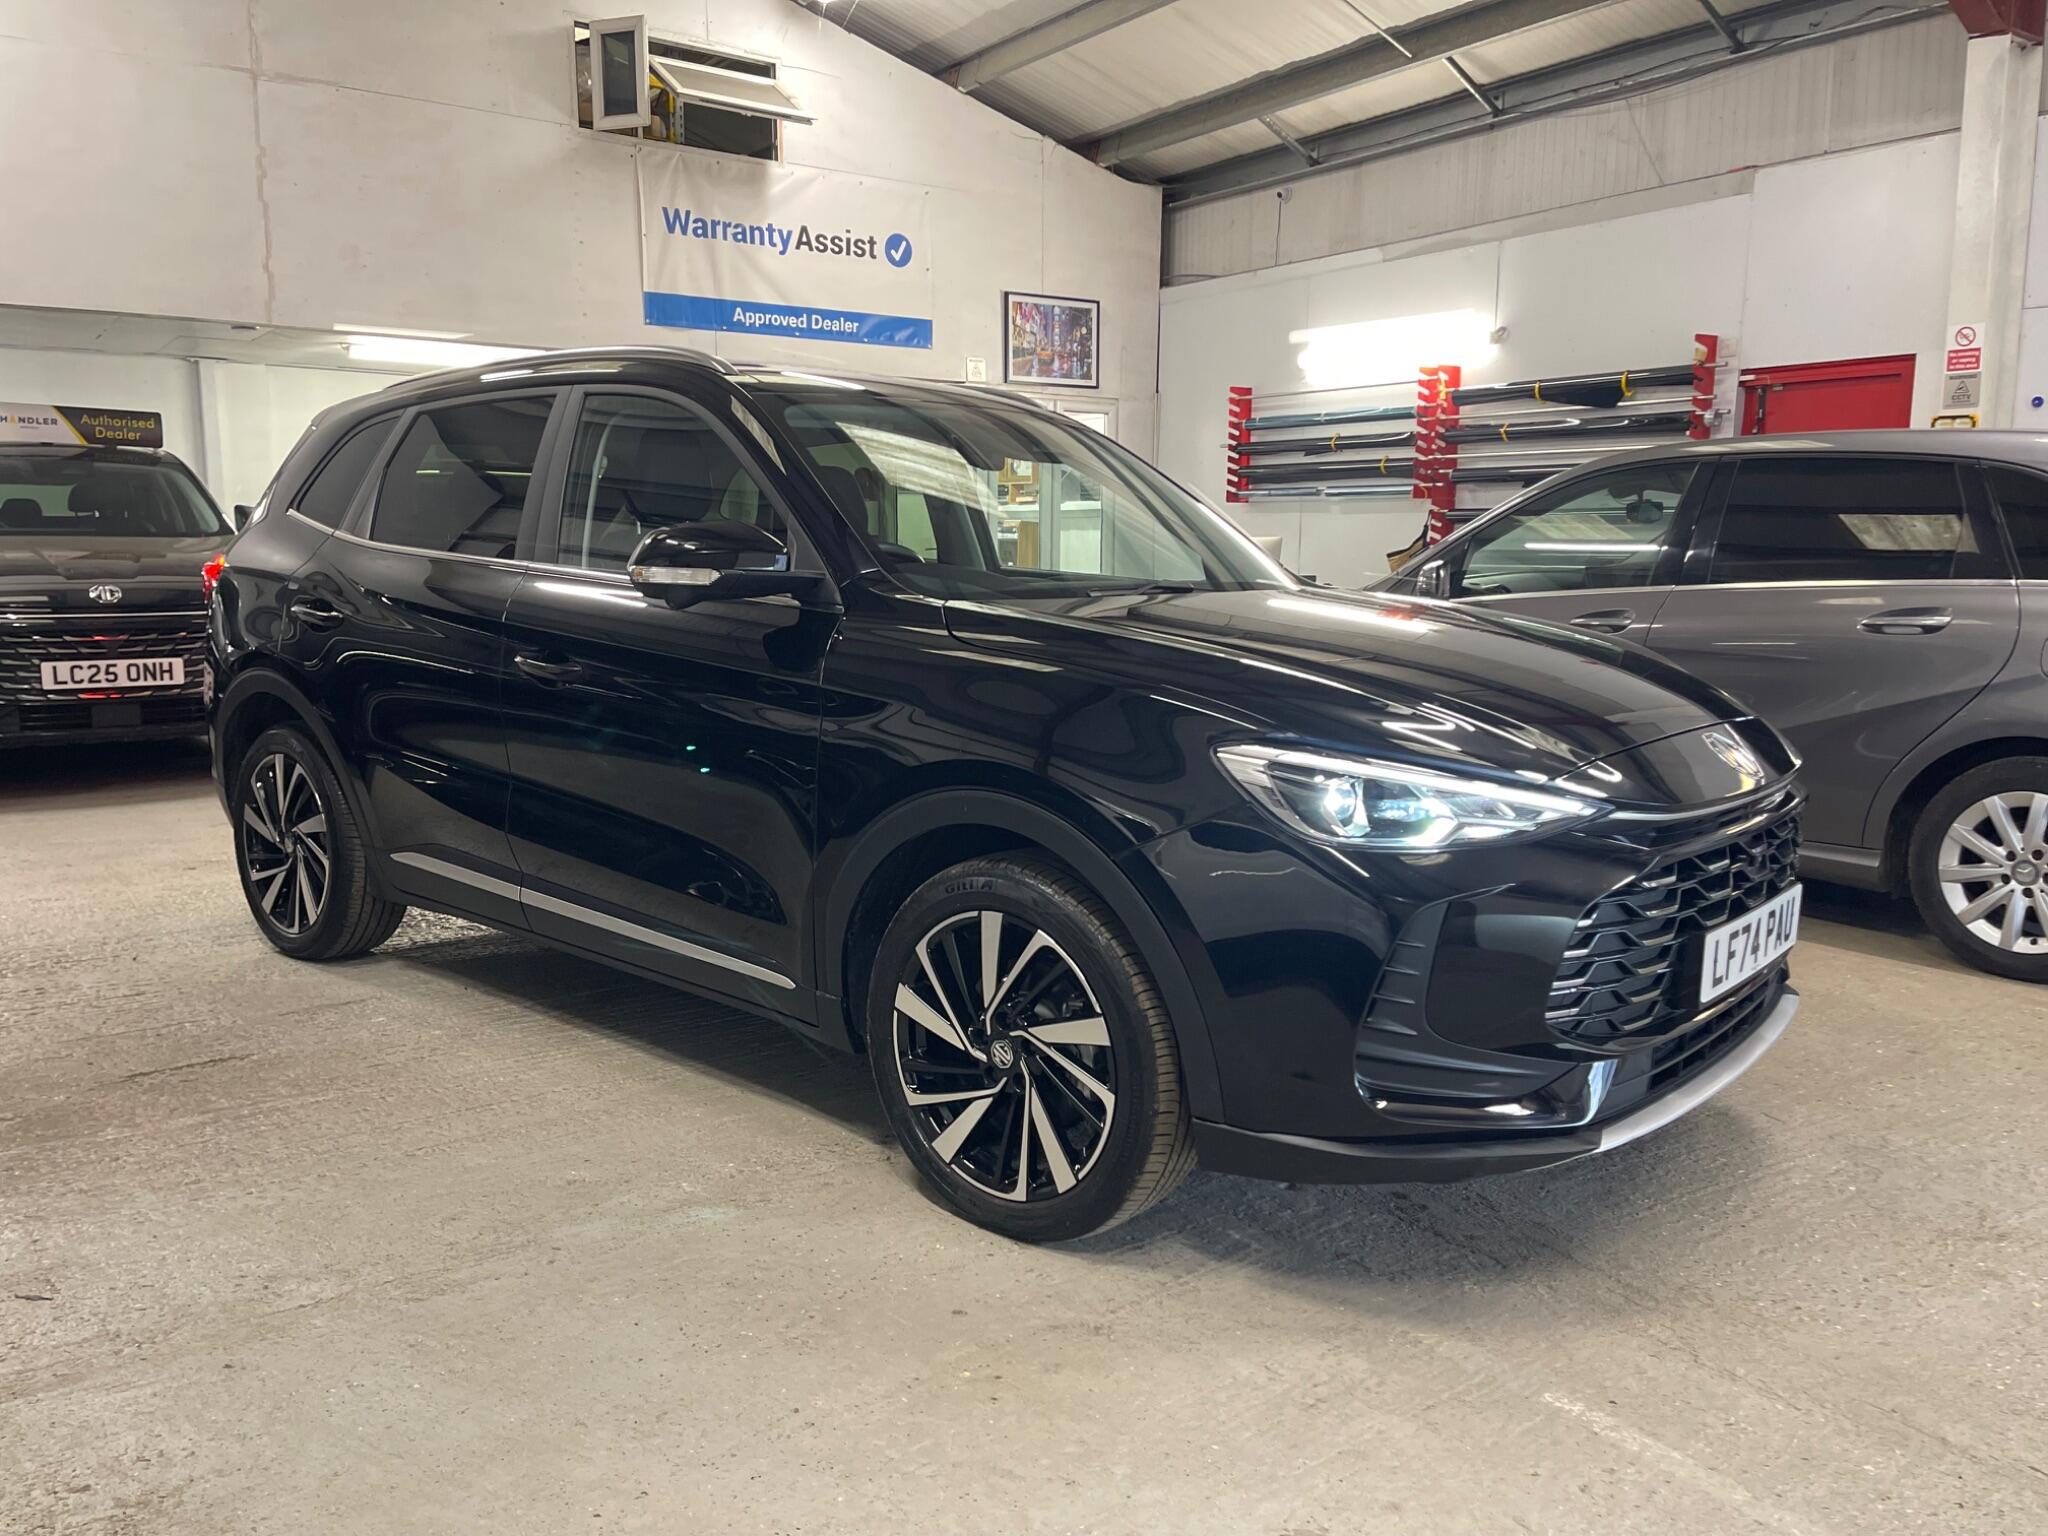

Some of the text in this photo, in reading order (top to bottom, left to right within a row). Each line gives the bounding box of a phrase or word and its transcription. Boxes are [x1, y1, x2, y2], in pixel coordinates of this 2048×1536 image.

[733, 308, 859, 333] Approved Dealer
[80, 414, 155, 429] Authorised
[95, 427, 141, 440] Dealer
[89, 585, 122, 603] MG
[52, 662, 174, 686] LC25 ONH
[1712, 896, 1796, 989] LF74 PAU
